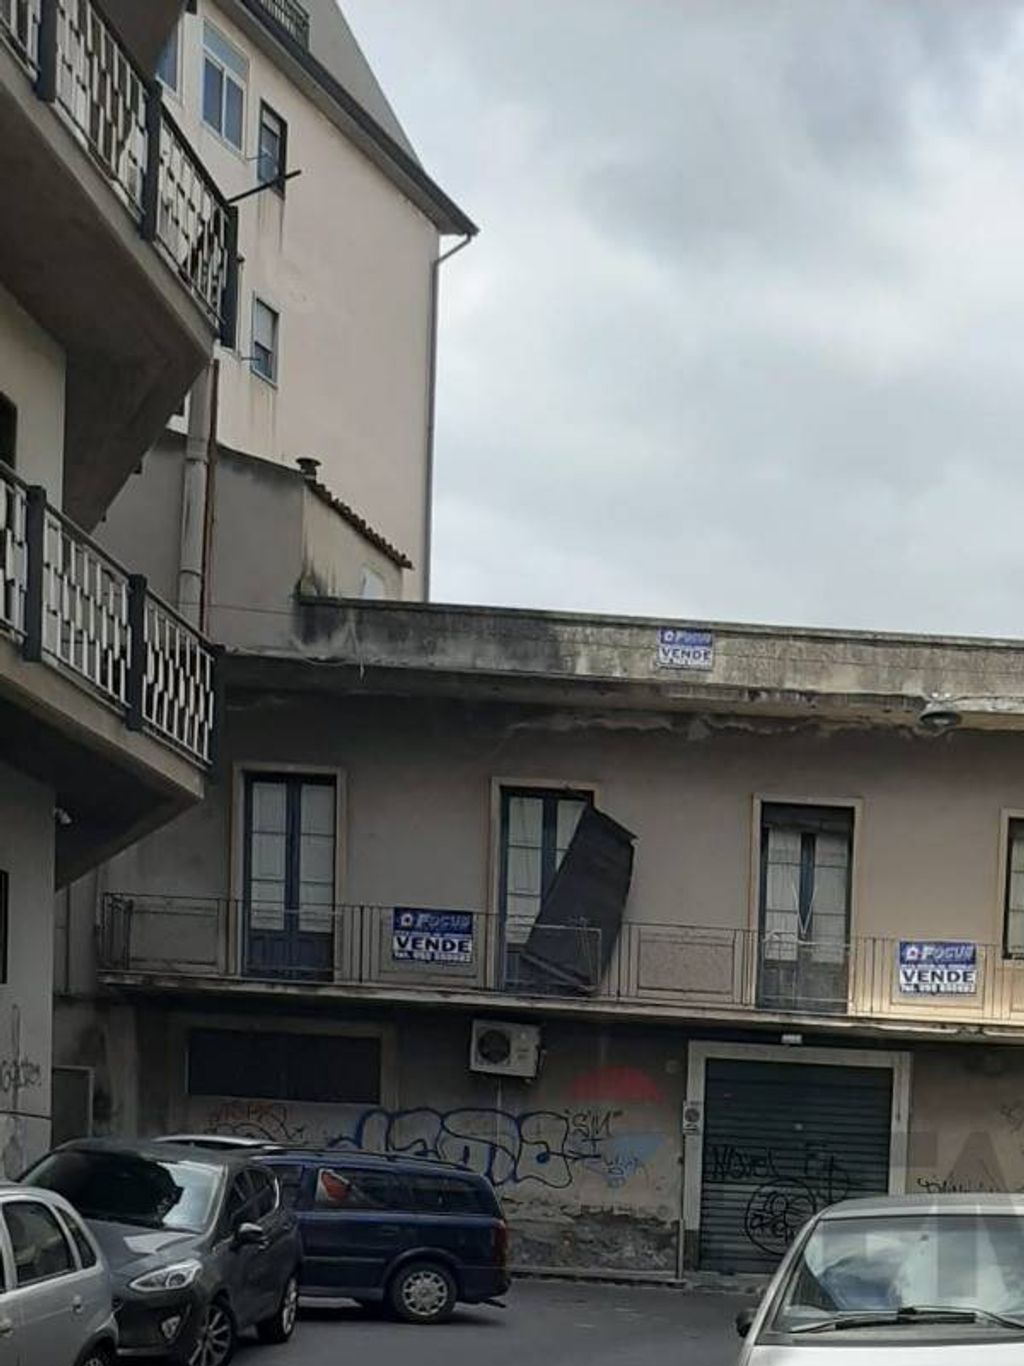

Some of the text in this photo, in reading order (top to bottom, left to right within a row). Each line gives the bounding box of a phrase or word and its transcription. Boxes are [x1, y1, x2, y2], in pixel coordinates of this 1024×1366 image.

[662, 648, 711, 660] VENDE
[397, 936, 471, 954] VENDE
[902, 970, 975, 984] VENDE
